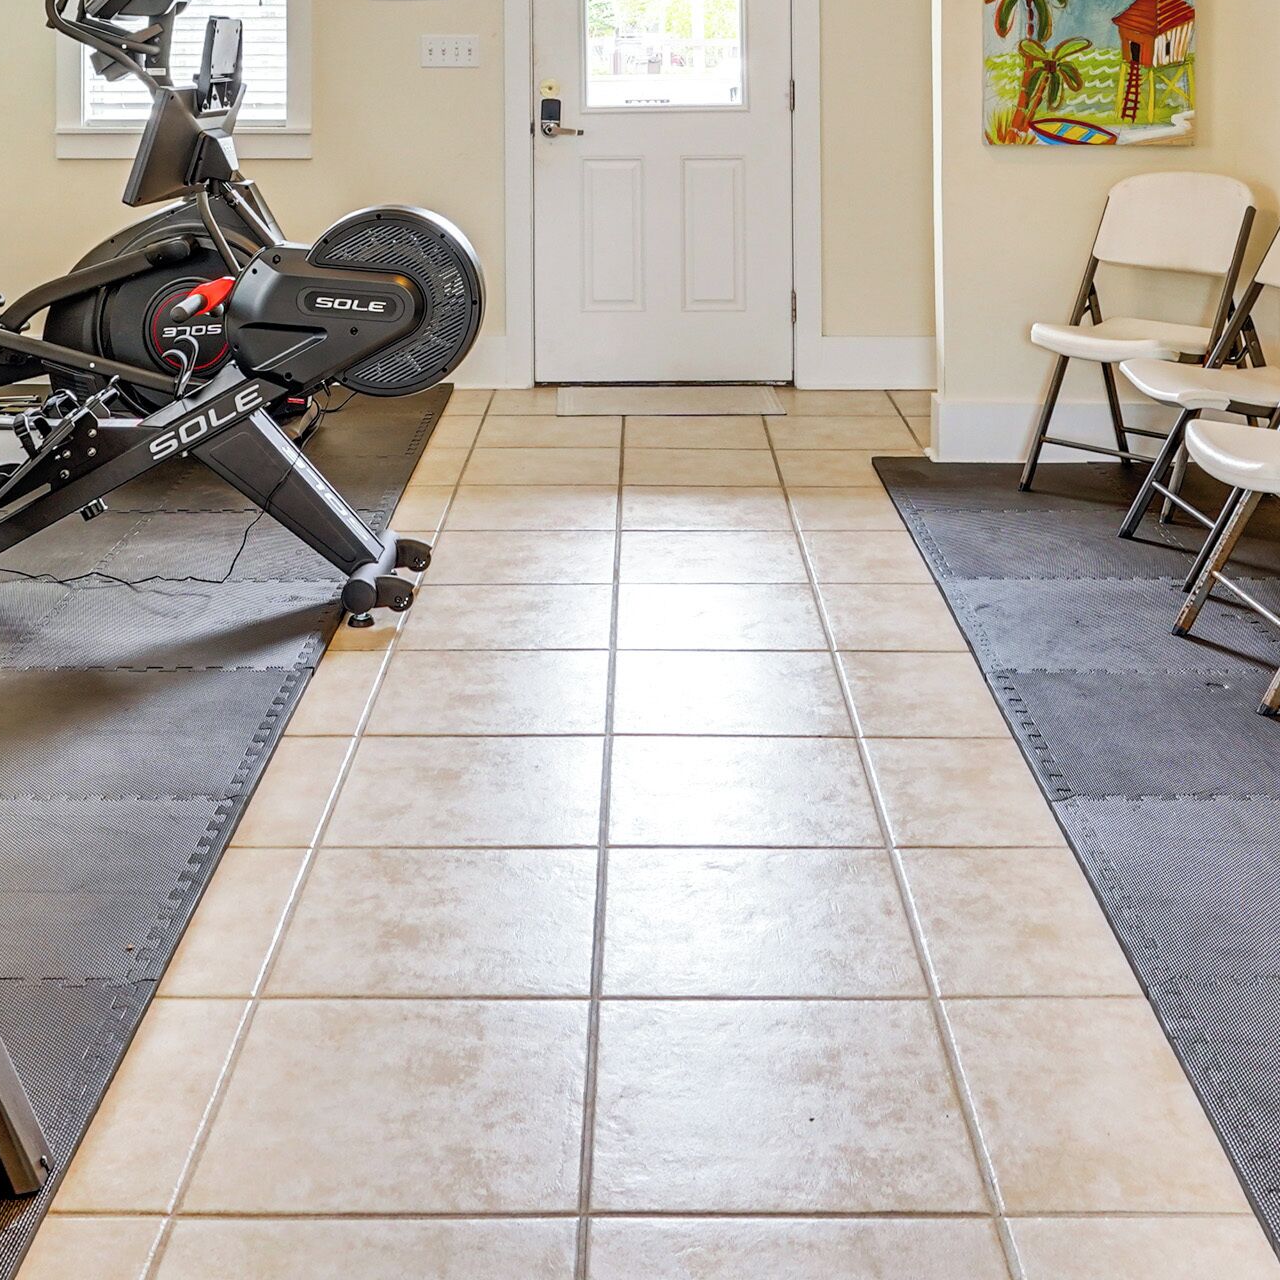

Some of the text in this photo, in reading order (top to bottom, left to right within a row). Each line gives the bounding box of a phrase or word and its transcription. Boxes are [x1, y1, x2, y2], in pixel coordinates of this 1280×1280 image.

[315, 296, 387, 313] SOLE
[162, 324, 222, 339] SOLE
[149, 383, 263, 461] SOLE
